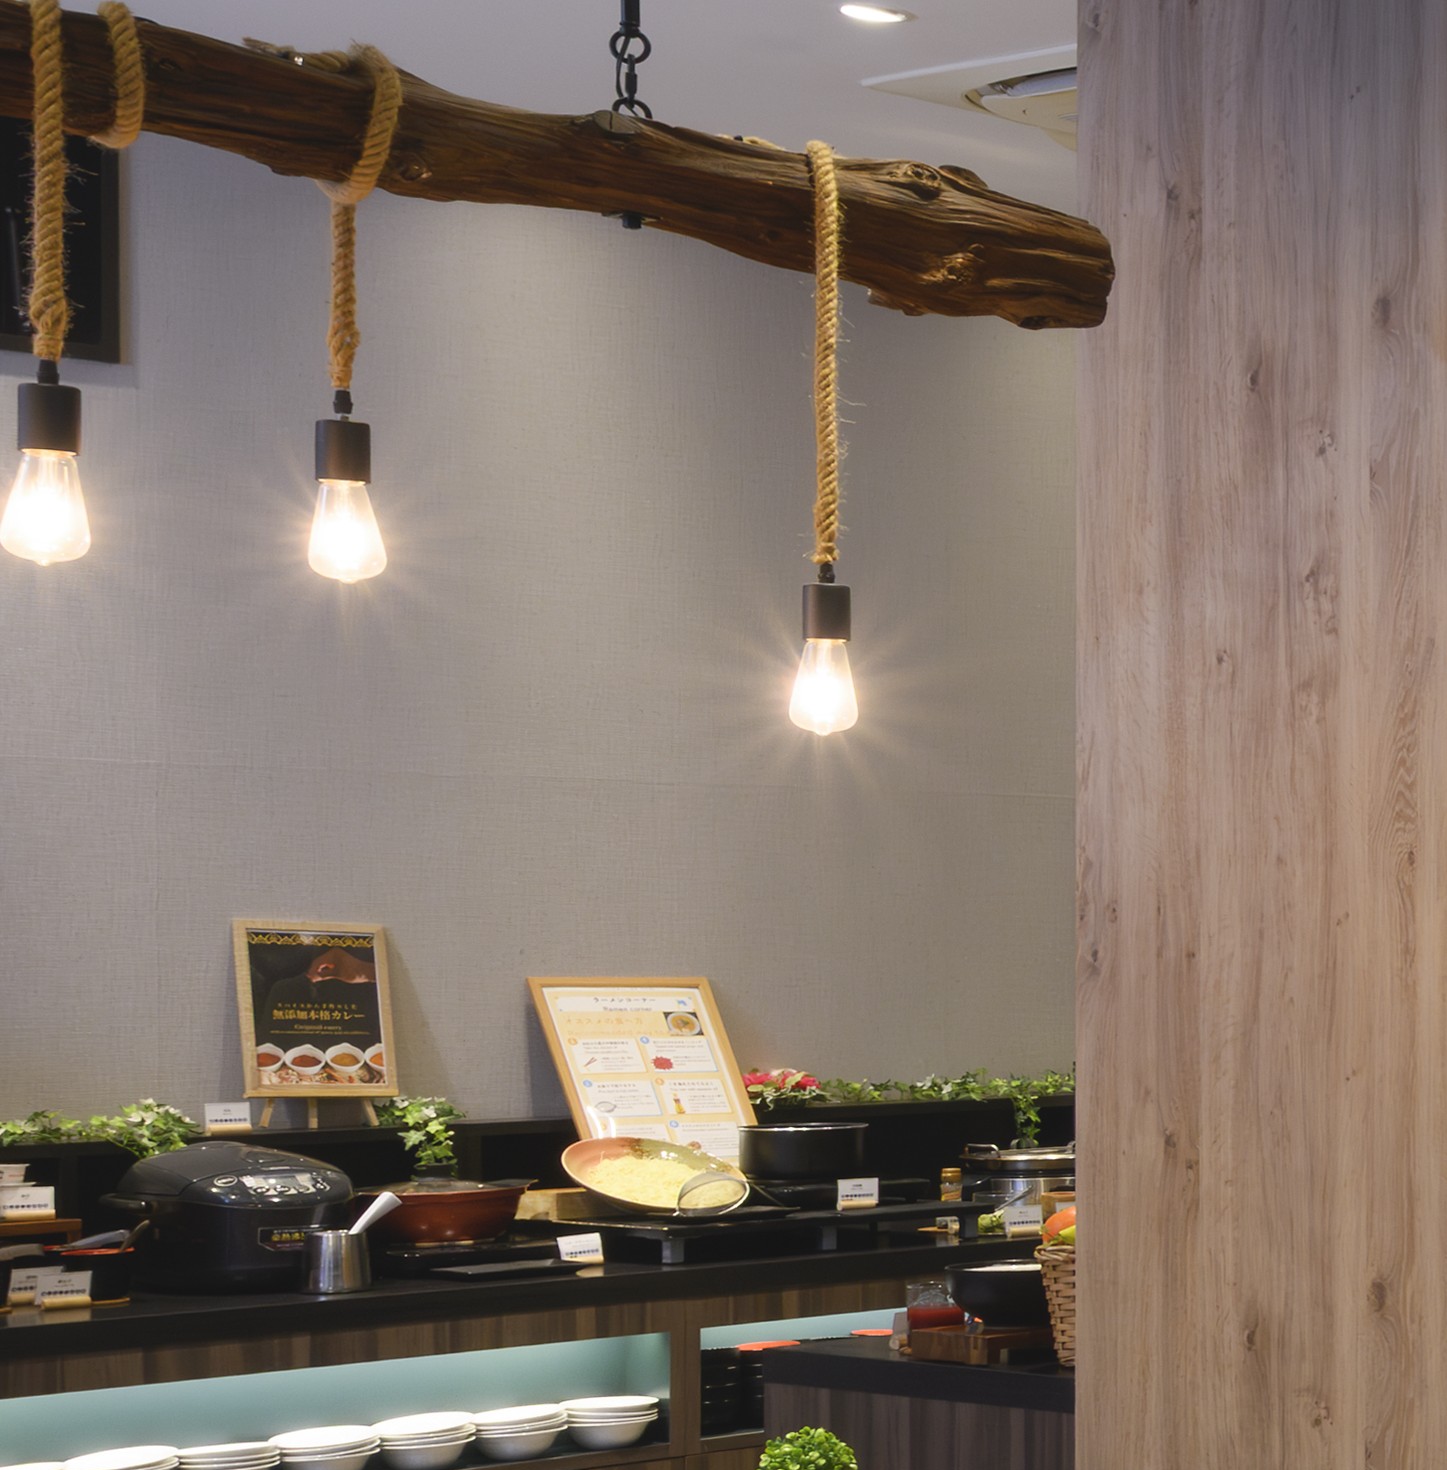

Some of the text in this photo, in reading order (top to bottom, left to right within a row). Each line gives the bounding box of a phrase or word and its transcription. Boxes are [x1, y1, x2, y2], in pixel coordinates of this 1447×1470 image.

[272, 1009, 366, 1021] 無添加本格カレー
